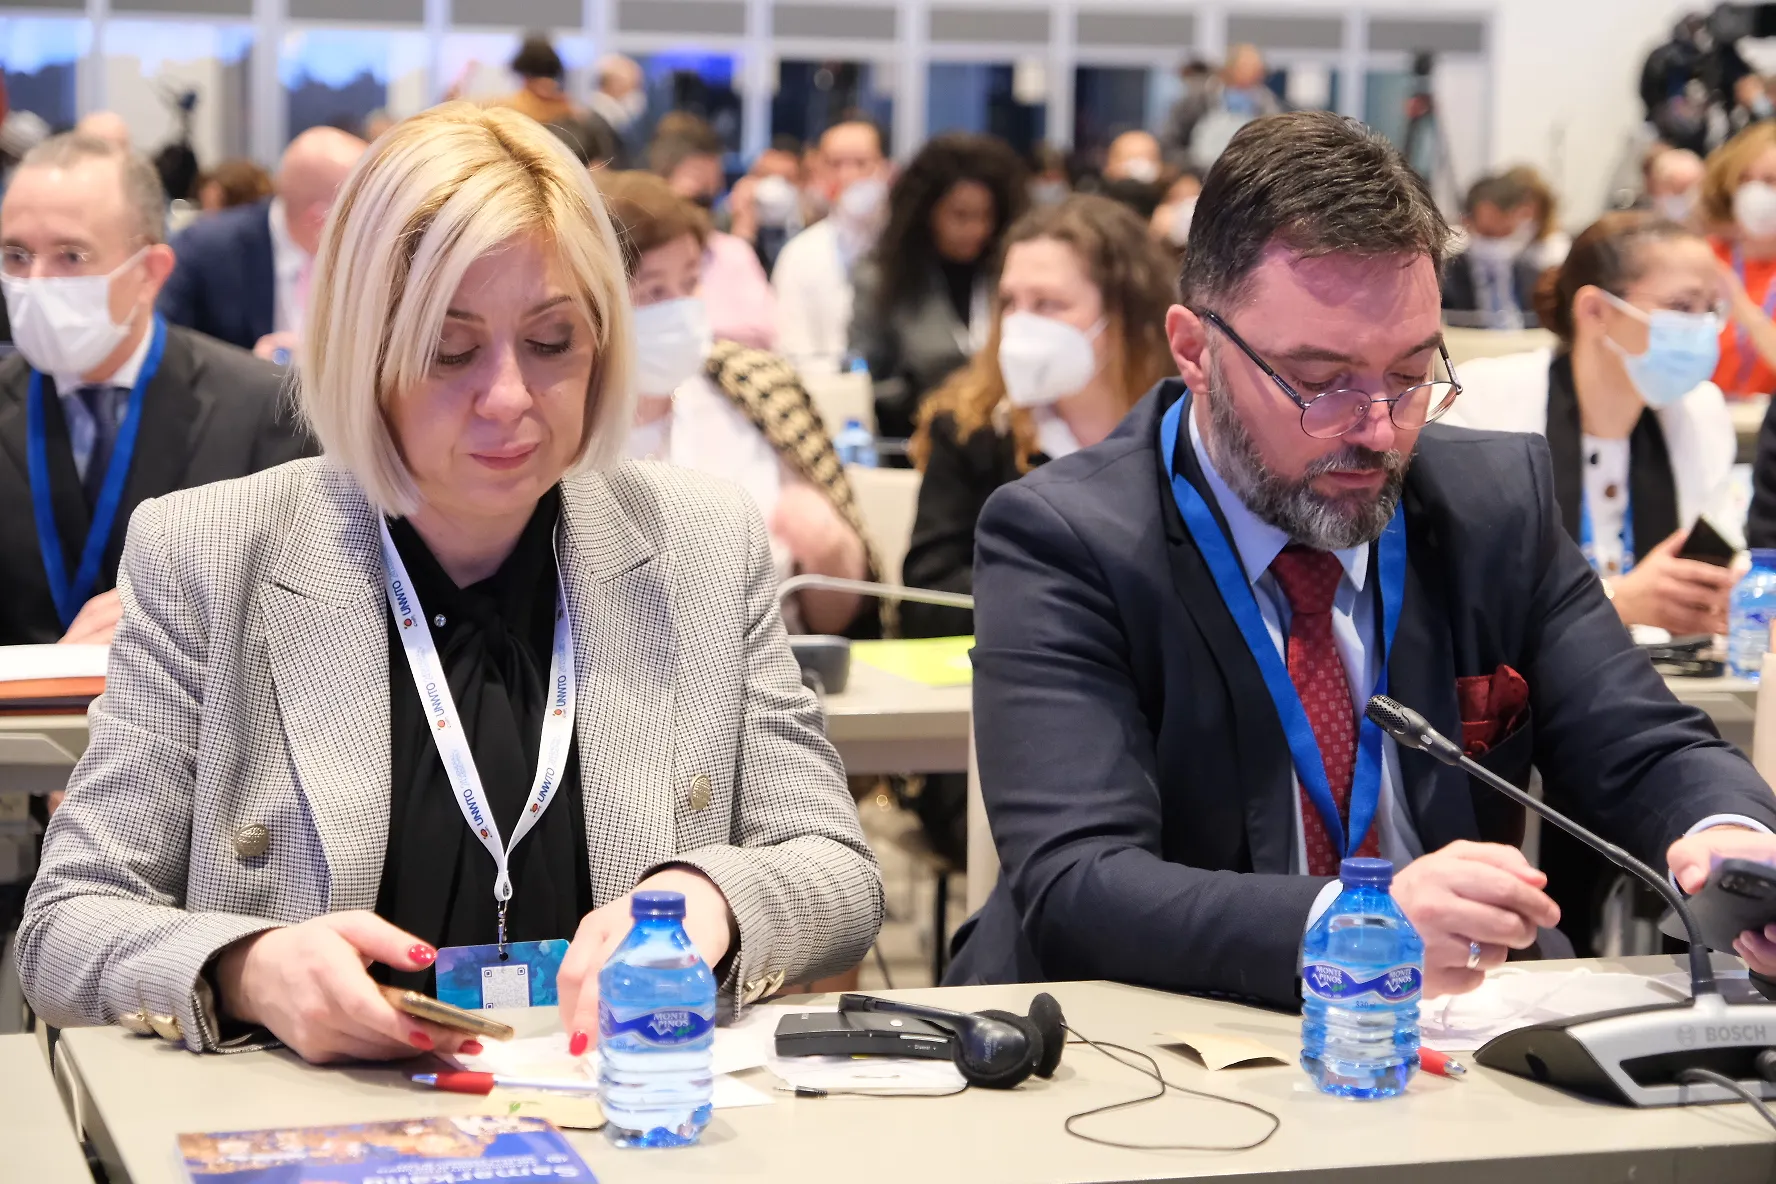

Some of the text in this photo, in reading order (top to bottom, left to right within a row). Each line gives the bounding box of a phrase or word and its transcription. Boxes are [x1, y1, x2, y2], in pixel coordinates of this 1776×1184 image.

[392, 580, 411, 616] UNWTO
[425, 682, 445, 717] UNWTO
[555, 675, 567, 707] UNWTO
[537, 767, 555, 802] UNWTO
[463, 788, 484, 827] UNWTO
[1316, 966, 1342, 979] MONTE
[1319, 973, 1342, 985] PINOS
[1389, 968, 1413, 978] MONTE
[653, 1012, 690, 1021] MONTE
[658, 1019, 690, 1028] PINOS
[1704, 1024, 1767, 1042] BOSCH
